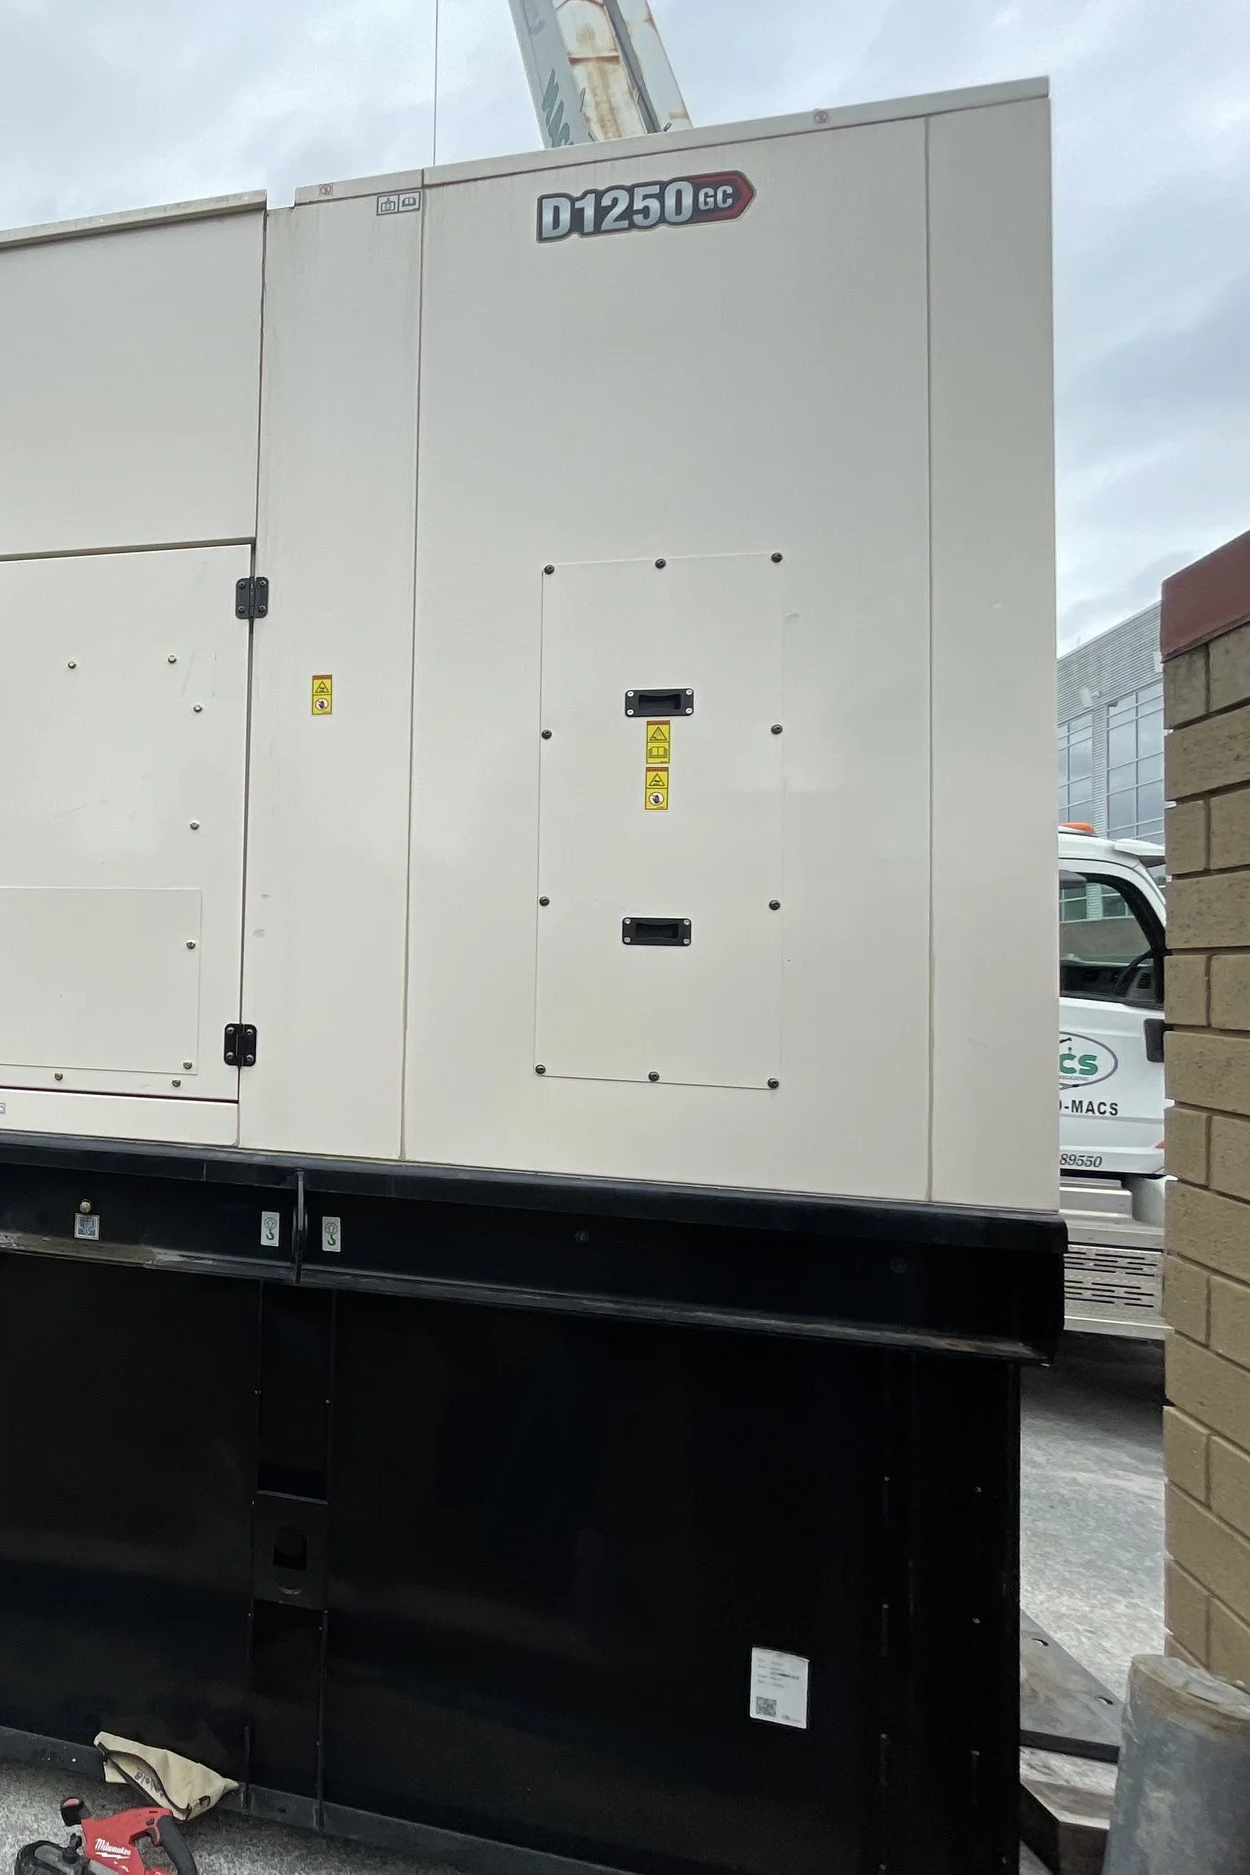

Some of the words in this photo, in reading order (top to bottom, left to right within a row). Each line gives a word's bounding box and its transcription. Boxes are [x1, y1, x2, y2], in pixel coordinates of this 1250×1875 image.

[542, 181, 693, 238] D1250
[698, 185, 734, 210] GC
[1059, 1099, 1119, 1116] -MACS
